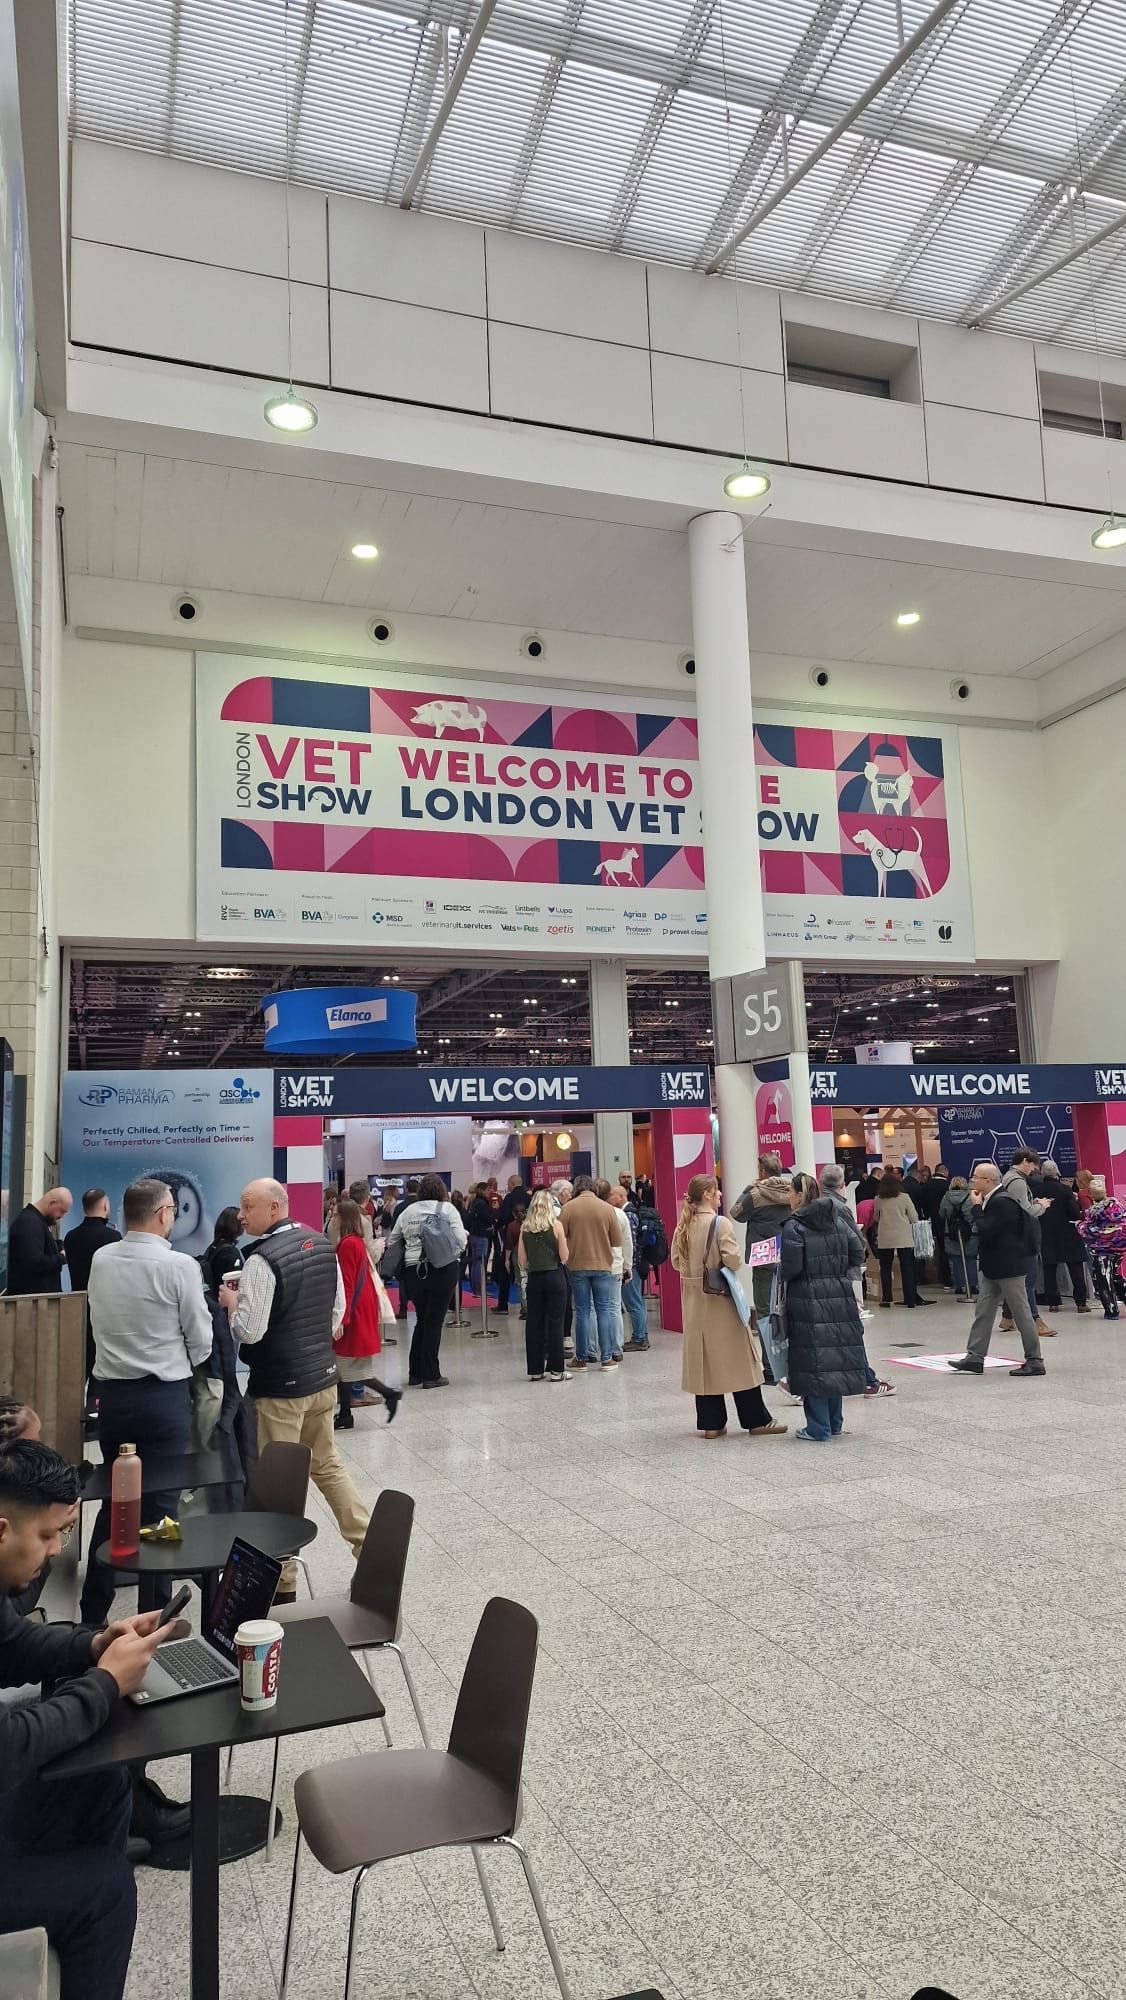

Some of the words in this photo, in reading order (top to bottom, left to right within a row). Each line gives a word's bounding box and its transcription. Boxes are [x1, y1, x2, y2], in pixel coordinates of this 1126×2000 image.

[255, 734, 372, 785] VET
[236, 731, 251, 808] LONDON
[398, 746, 626, 796] WELCOME
[638, 766, 693, 799] TO
[256, 781, 372, 815] SHOW
[401, 786, 593, 830] LONDON
[606, 800, 686, 835] VET
[254, 908, 276, 919] BVA
[443, 904, 472, 912] IDEXX
[555, 906, 573, 915] Lupa
[301, 910, 323, 921] BVA
[421, 921, 493, 931] veterinaryit.services
[547, 925, 574, 935] zoetis
[330, 1009, 372, 1022] Elanco
[743, 988, 782, 1036] S5
[287, 1076, 335, 1095] VET
[660, 1072, 668, 1101] LONDON
[666, 1071, 705, 1089] VET
[910, 1073, 1031, 1097] WELCOME
[429, 1077, 580, 1102] WELCOME
[668, 1088, 705, 1101] SHOW
[810, 1087, 838, 1099] HOW
[118, 1094, 170, 1104] PHARMA
[287, 1095, 335, 1108] SHOW
[83, 1127, 124, 1136] Perfectly
[127, 1125, 160, 1135] Chilled,
[163, 1125, 203, 1134] Perfectly
[219, 1124, 241, 1132] Time
[82, 1139, 100, 1147] Our
[104, 1135, 211, 1147] Temperature-Controlled
[213, 1134, 255, 1144] Deliveries
[759, 1131, 792, 1144] WELCOME
[267, 1648, 278, 1693] COSTA
